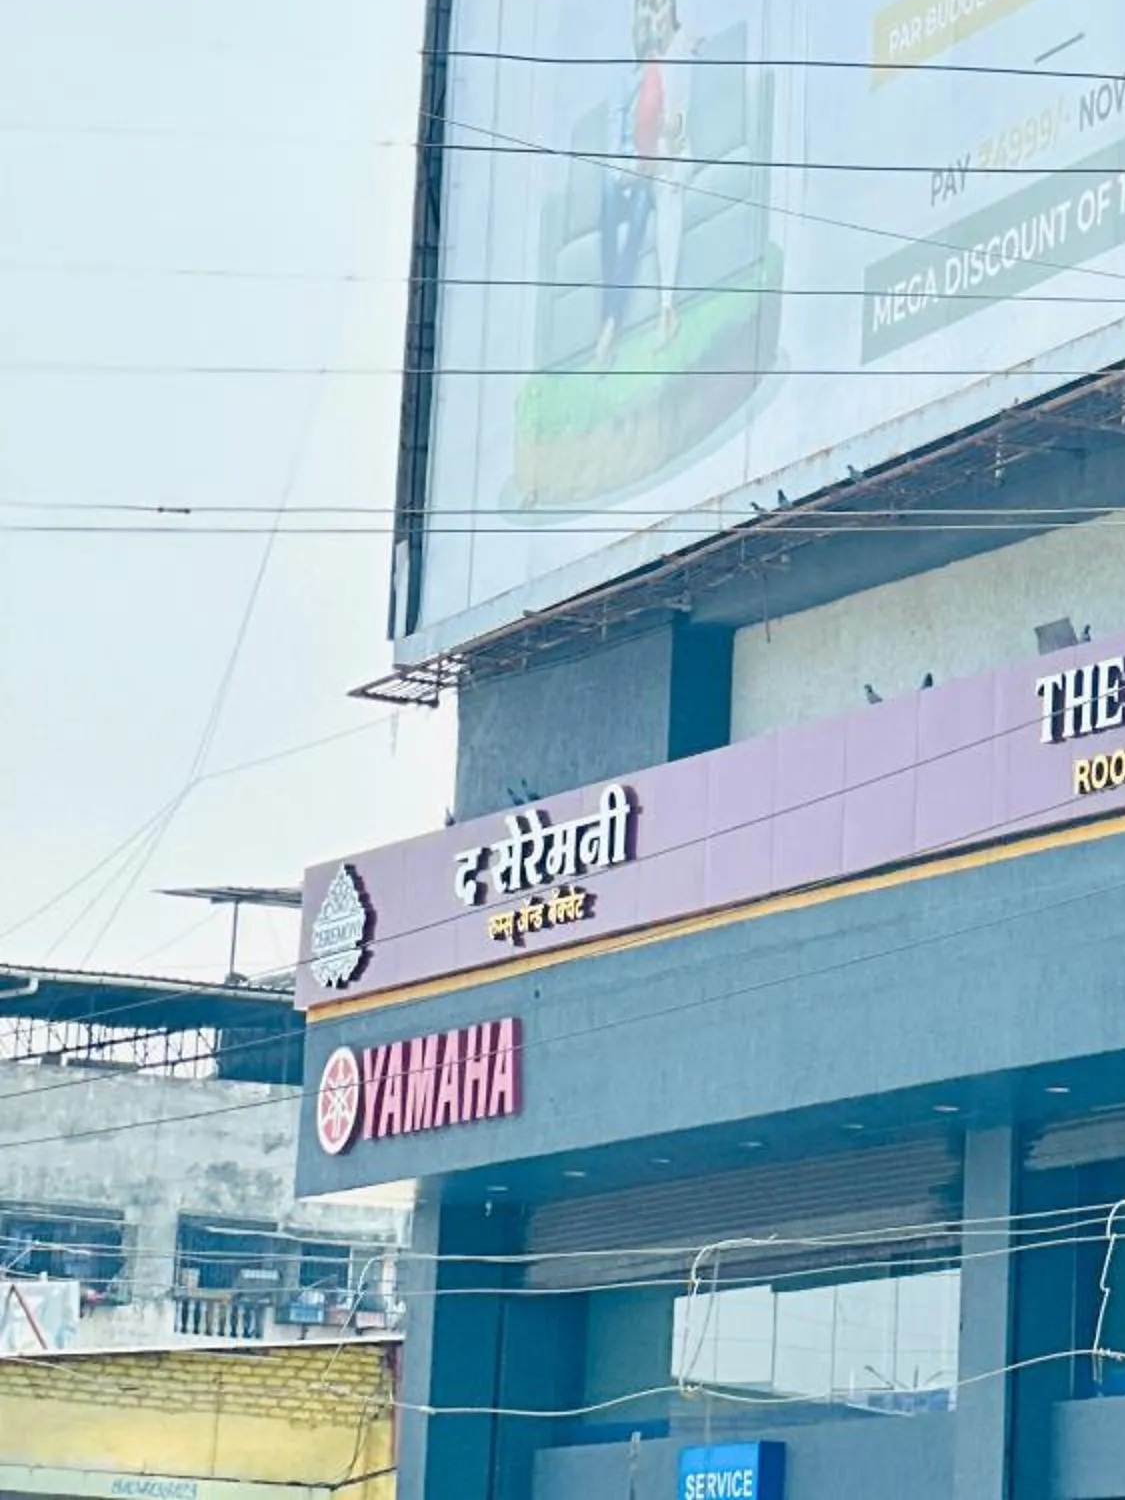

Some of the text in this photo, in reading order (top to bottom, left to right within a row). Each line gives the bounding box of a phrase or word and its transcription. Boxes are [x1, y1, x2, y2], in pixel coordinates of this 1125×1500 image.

[887, 18, 923, 60] PAR
[930, 150, 972, 208] PAY
[872, 267, 940, 332] MEGA
[944, 200, 1071, 296] DISCOUNT
[1077, 178, 1113, 233] OF
[453, 847, 486, 906] द
[361, 1016, 514, 1141] YAMAHA
[685, 1468, 754, 1500] SERVICE
